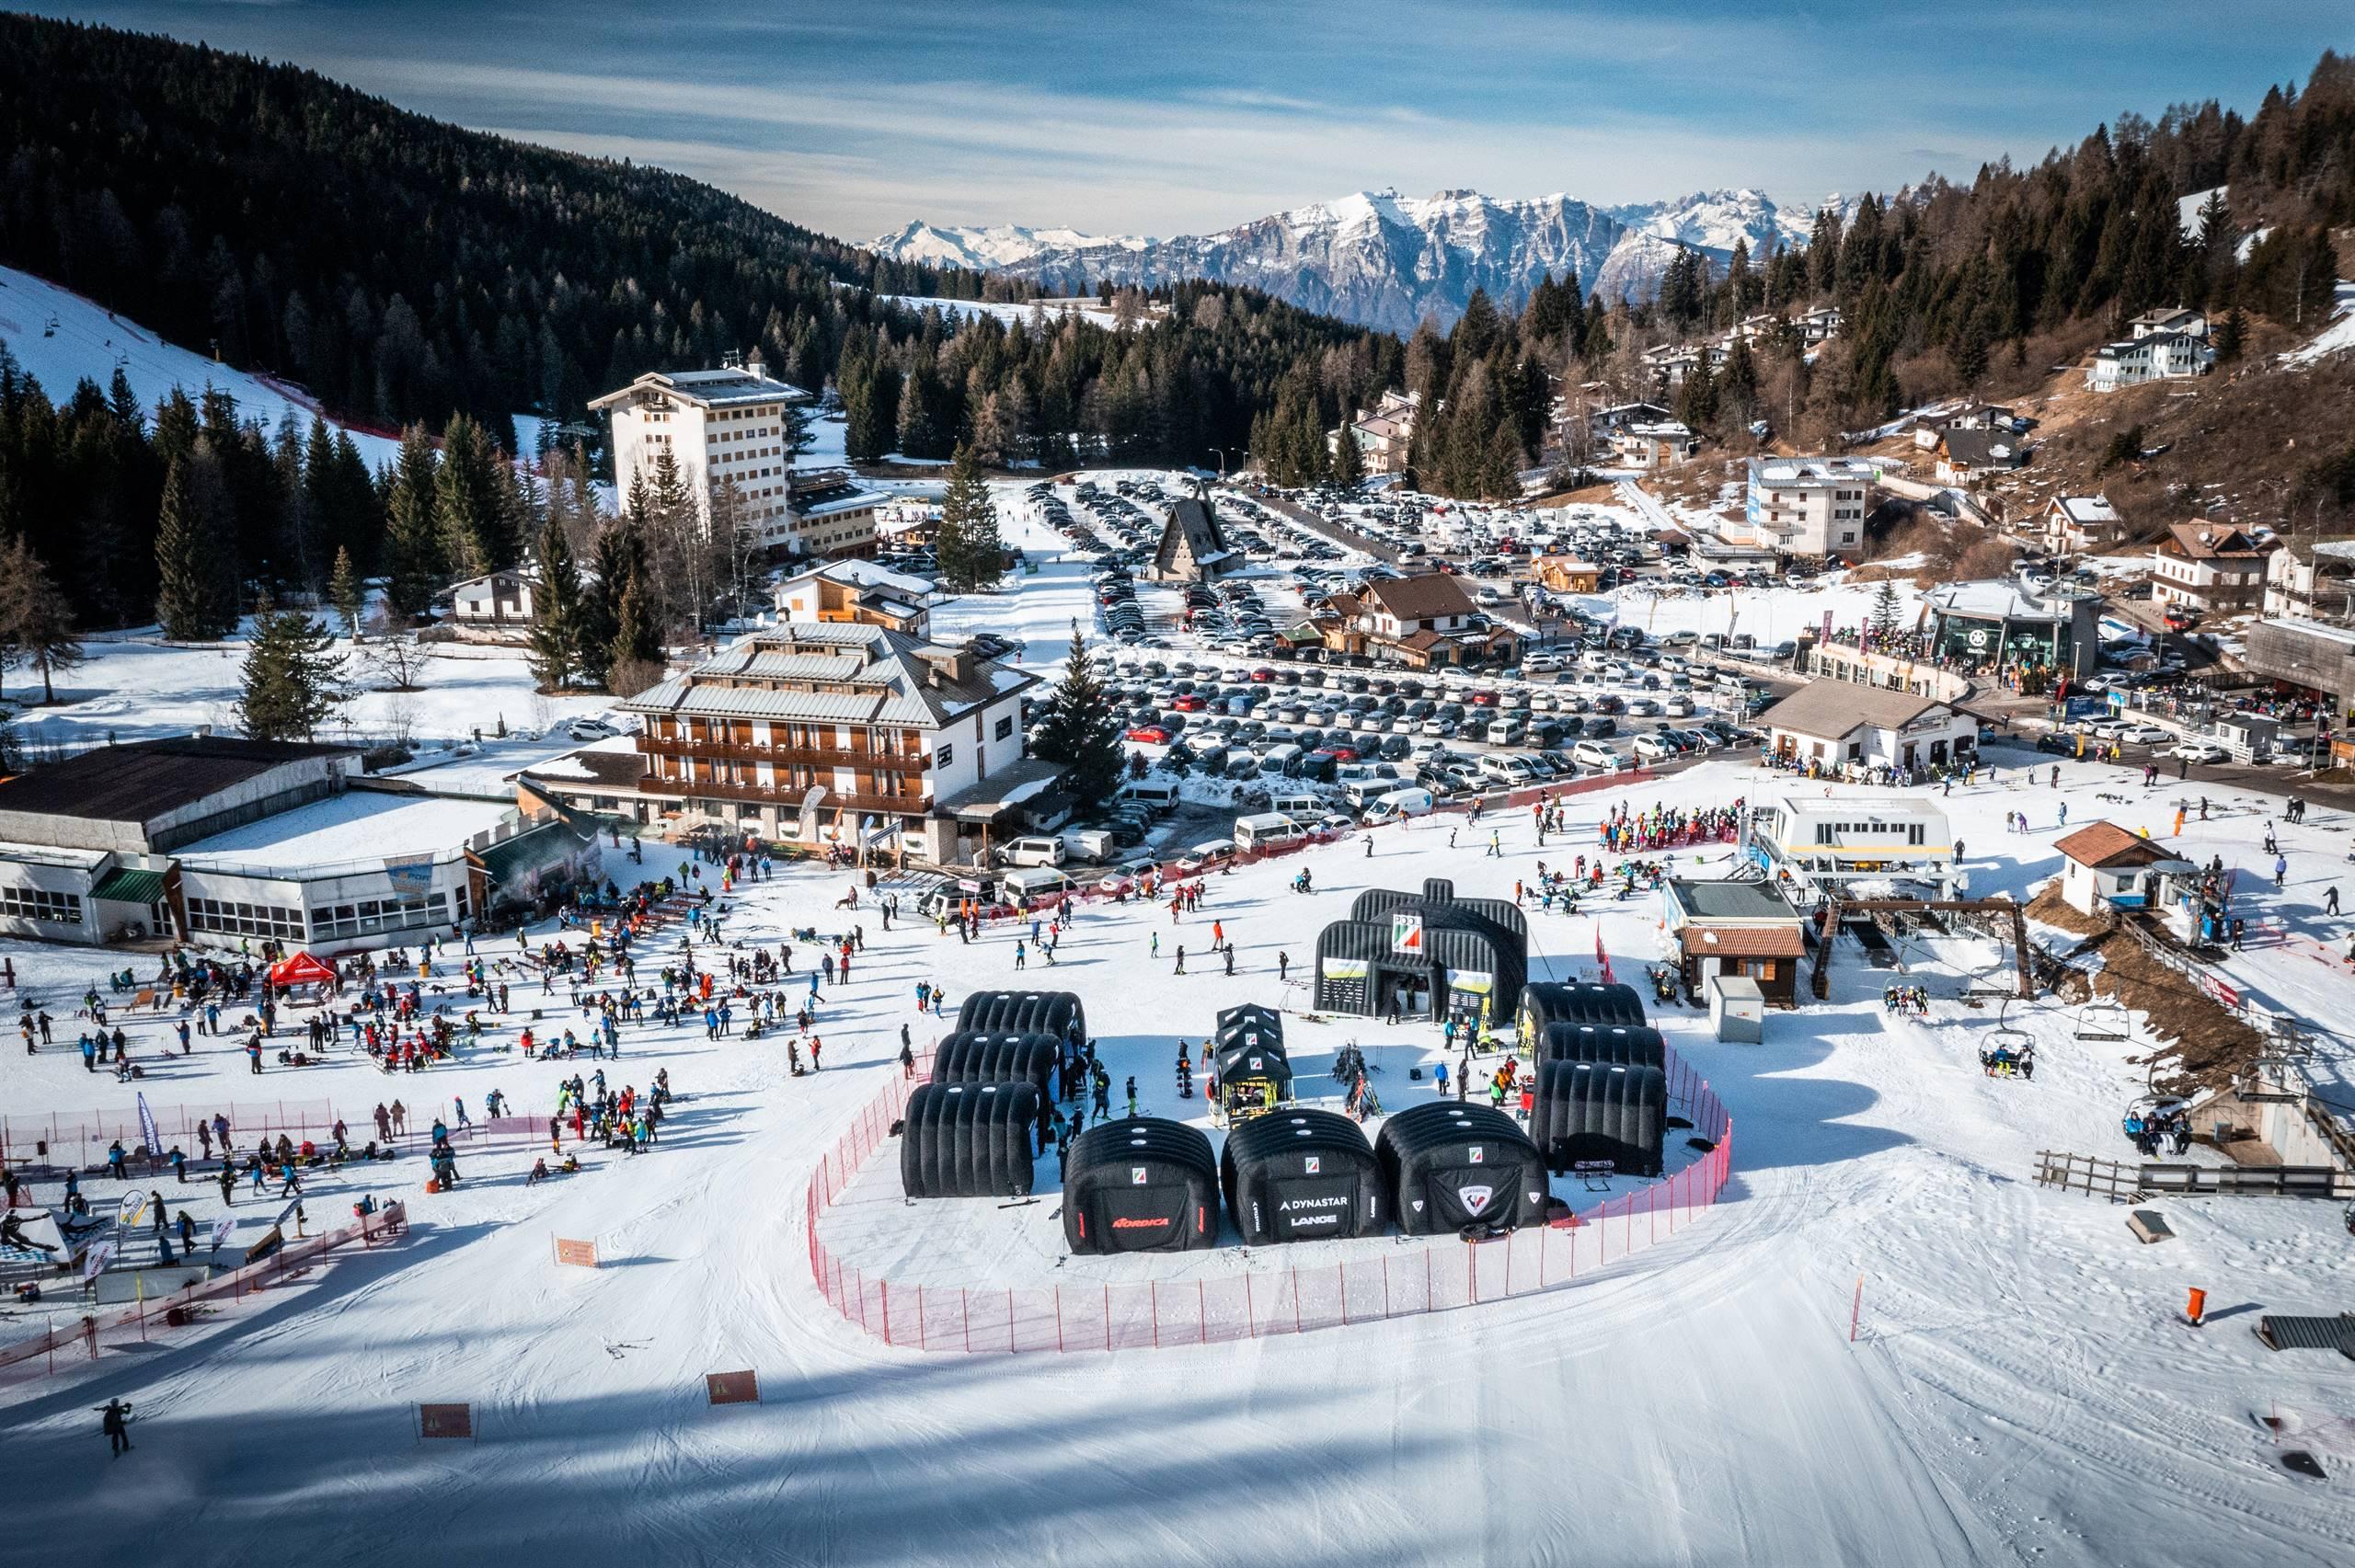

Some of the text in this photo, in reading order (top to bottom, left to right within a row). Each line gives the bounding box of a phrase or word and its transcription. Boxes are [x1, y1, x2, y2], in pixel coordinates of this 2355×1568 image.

[1395, 916, 1420, 925] POOL
[1292, 1196, 1348, 1209] DYNASTAR
[1112, 1217, 1169, 1229] NORDICA
[1291, 1215, 1338, 1226] LANGE
